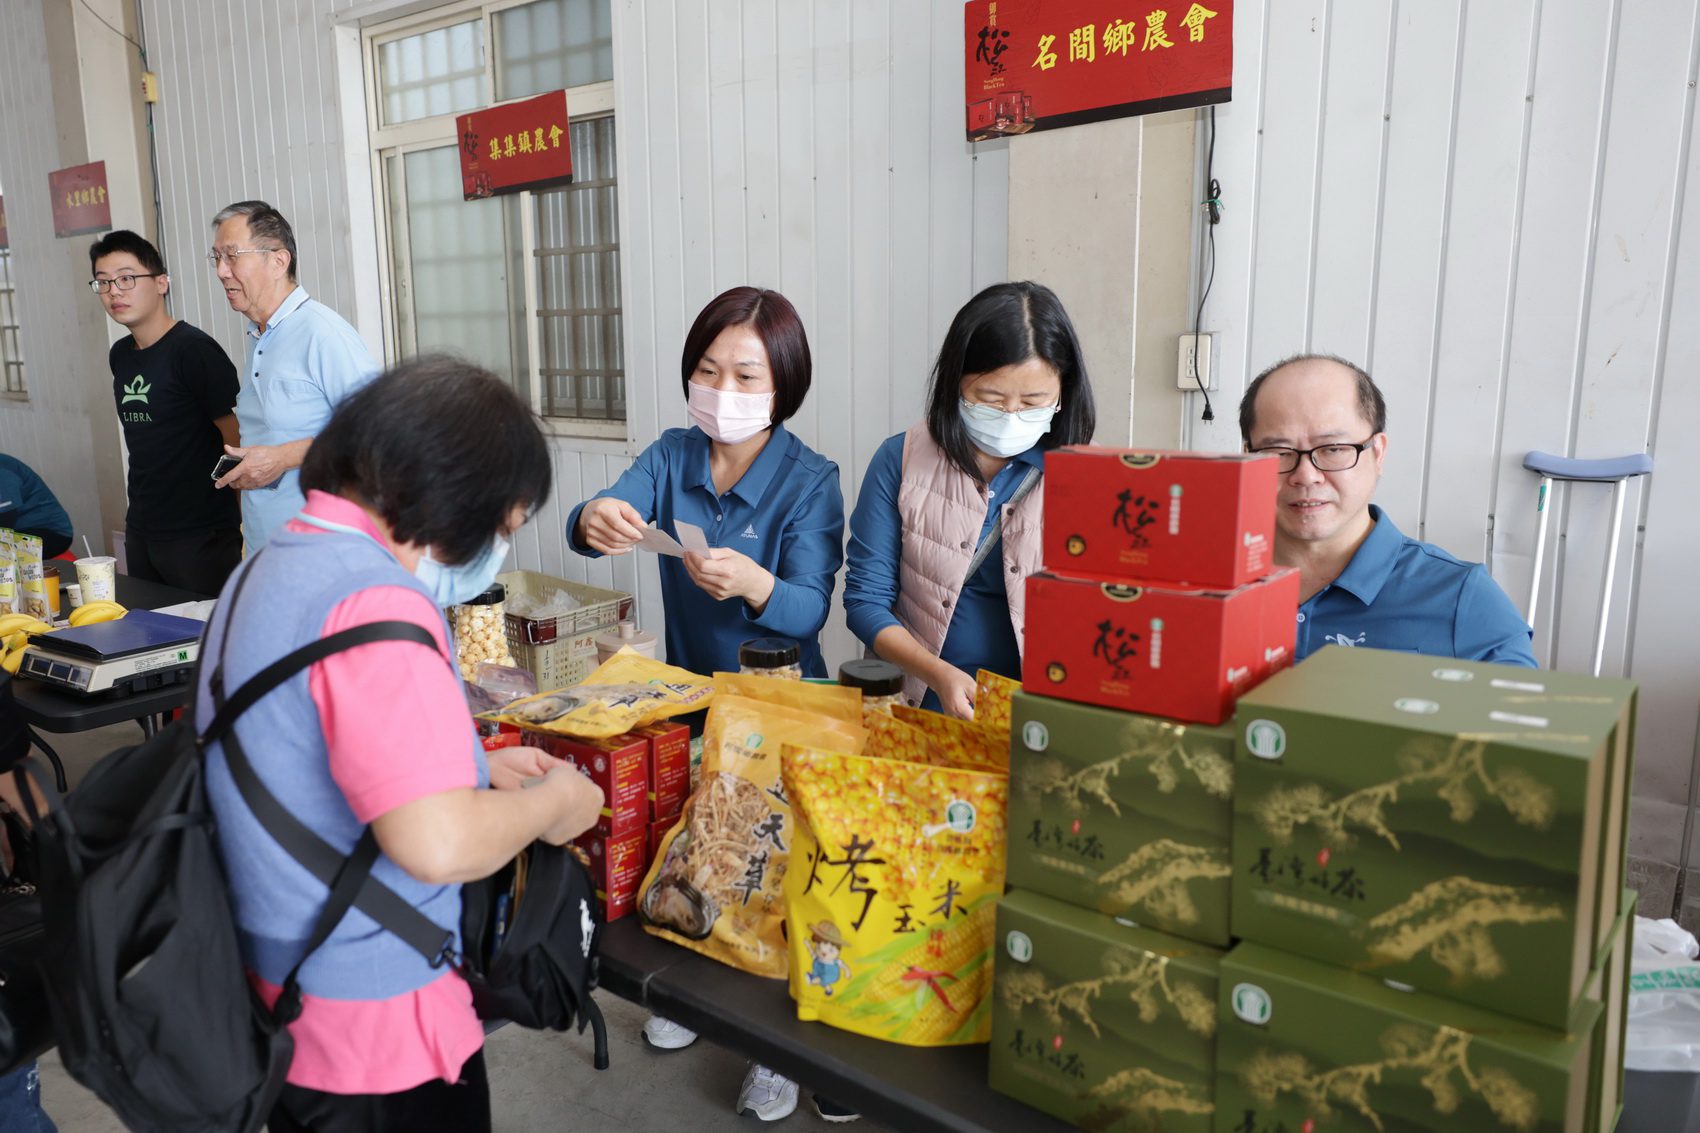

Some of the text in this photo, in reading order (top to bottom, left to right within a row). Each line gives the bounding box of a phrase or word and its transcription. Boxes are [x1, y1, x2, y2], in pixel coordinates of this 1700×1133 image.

[1032, 2, 1218, 71] 名間鄉農會
[489, 124, 564, 160] 集集鎮農會
[123, 412, 152, 422] LIBRA
[179, 651, 188, 661] M
